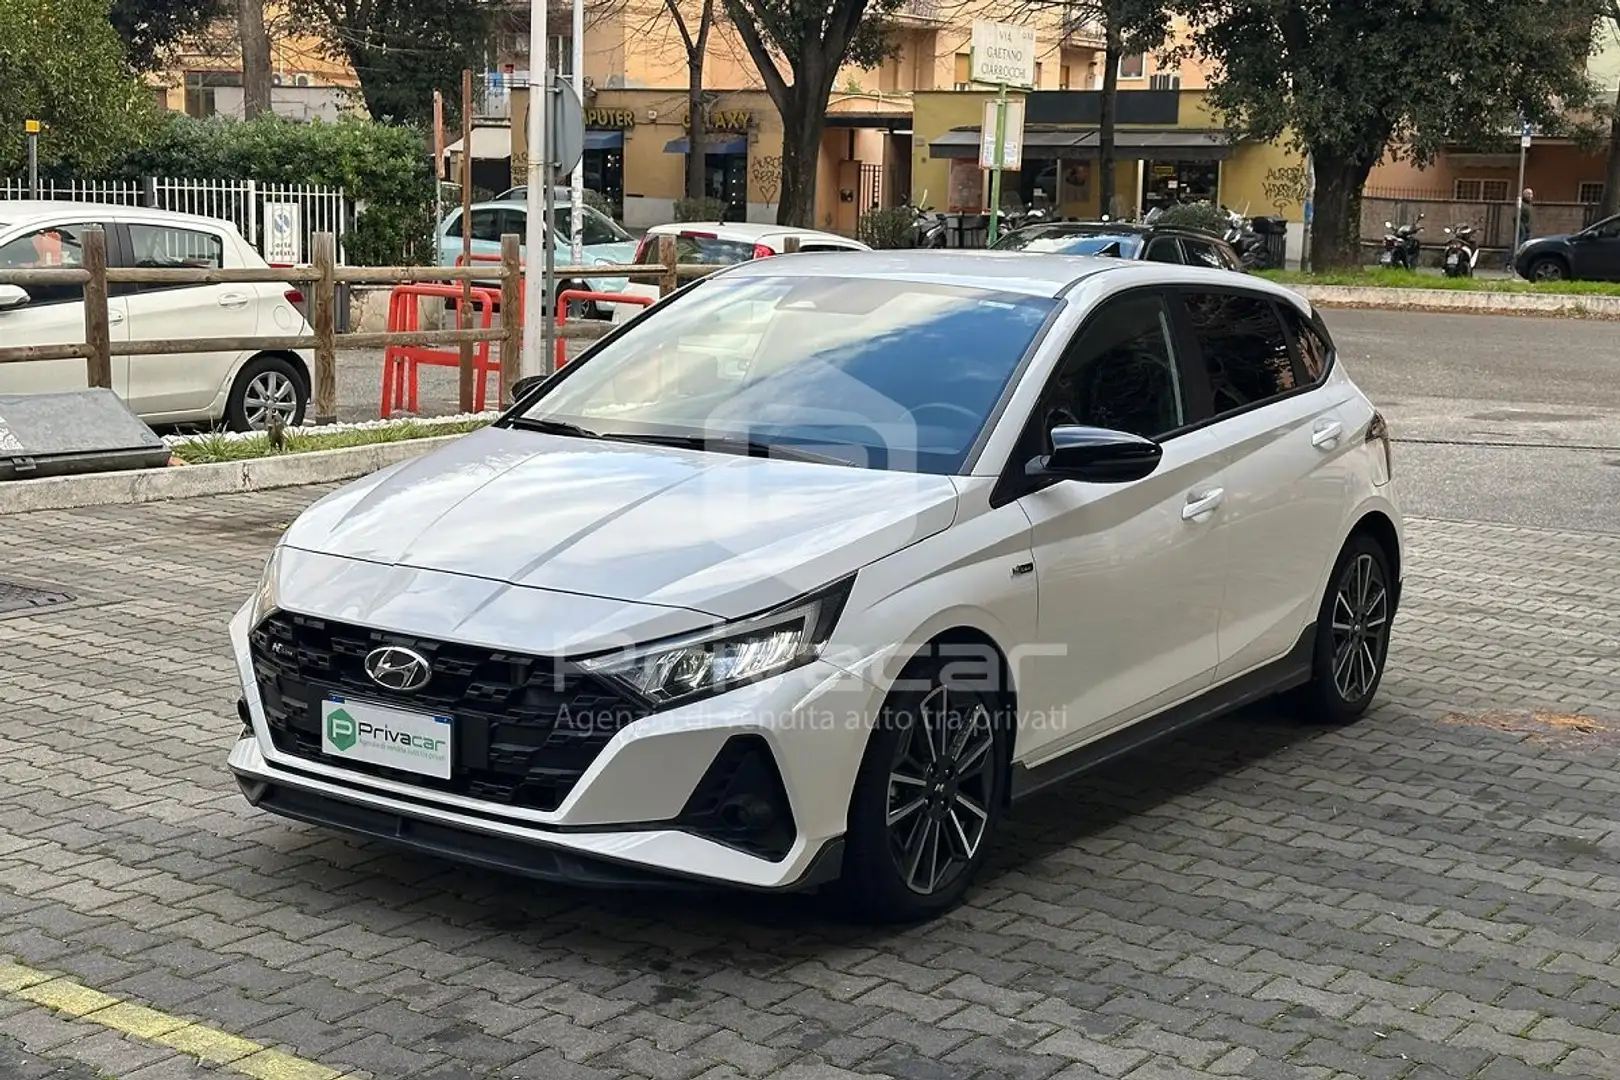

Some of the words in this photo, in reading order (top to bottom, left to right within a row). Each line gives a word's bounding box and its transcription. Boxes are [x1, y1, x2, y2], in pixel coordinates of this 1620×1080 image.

[999, 31, 1012, 42] VIA
[986, 46, 1022, 62] GAETANO
[681, 111, 750, 130] GLAXY
[358, 721, 447, 752] Privacar
